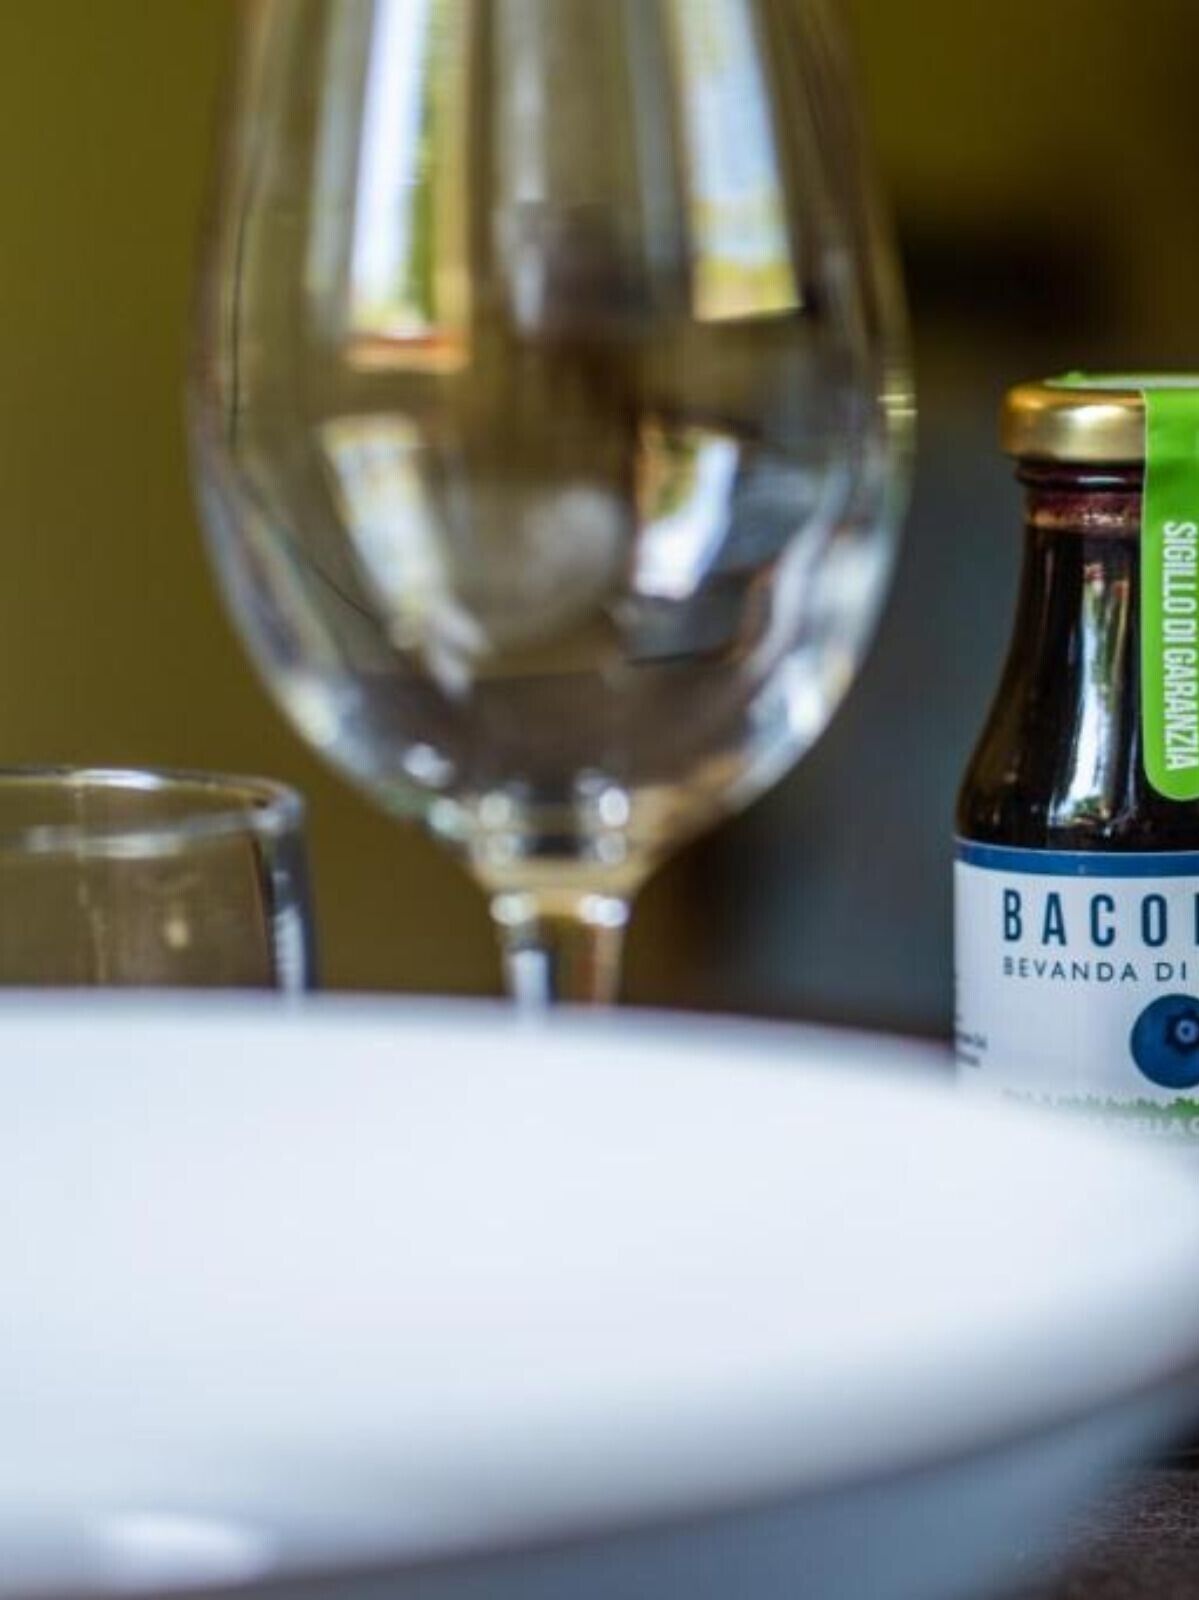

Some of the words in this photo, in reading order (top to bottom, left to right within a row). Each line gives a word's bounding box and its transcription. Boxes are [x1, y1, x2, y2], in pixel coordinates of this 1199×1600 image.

[1162, 521, 1198, 613] SIGILLO
[1162, 618, 1198, 643] DI
[1163, 648, 1199, 771] GARANZIA
[1003, 956, 1138, 982] BEVANDA
[1155, 961, 1188, 982] DI
